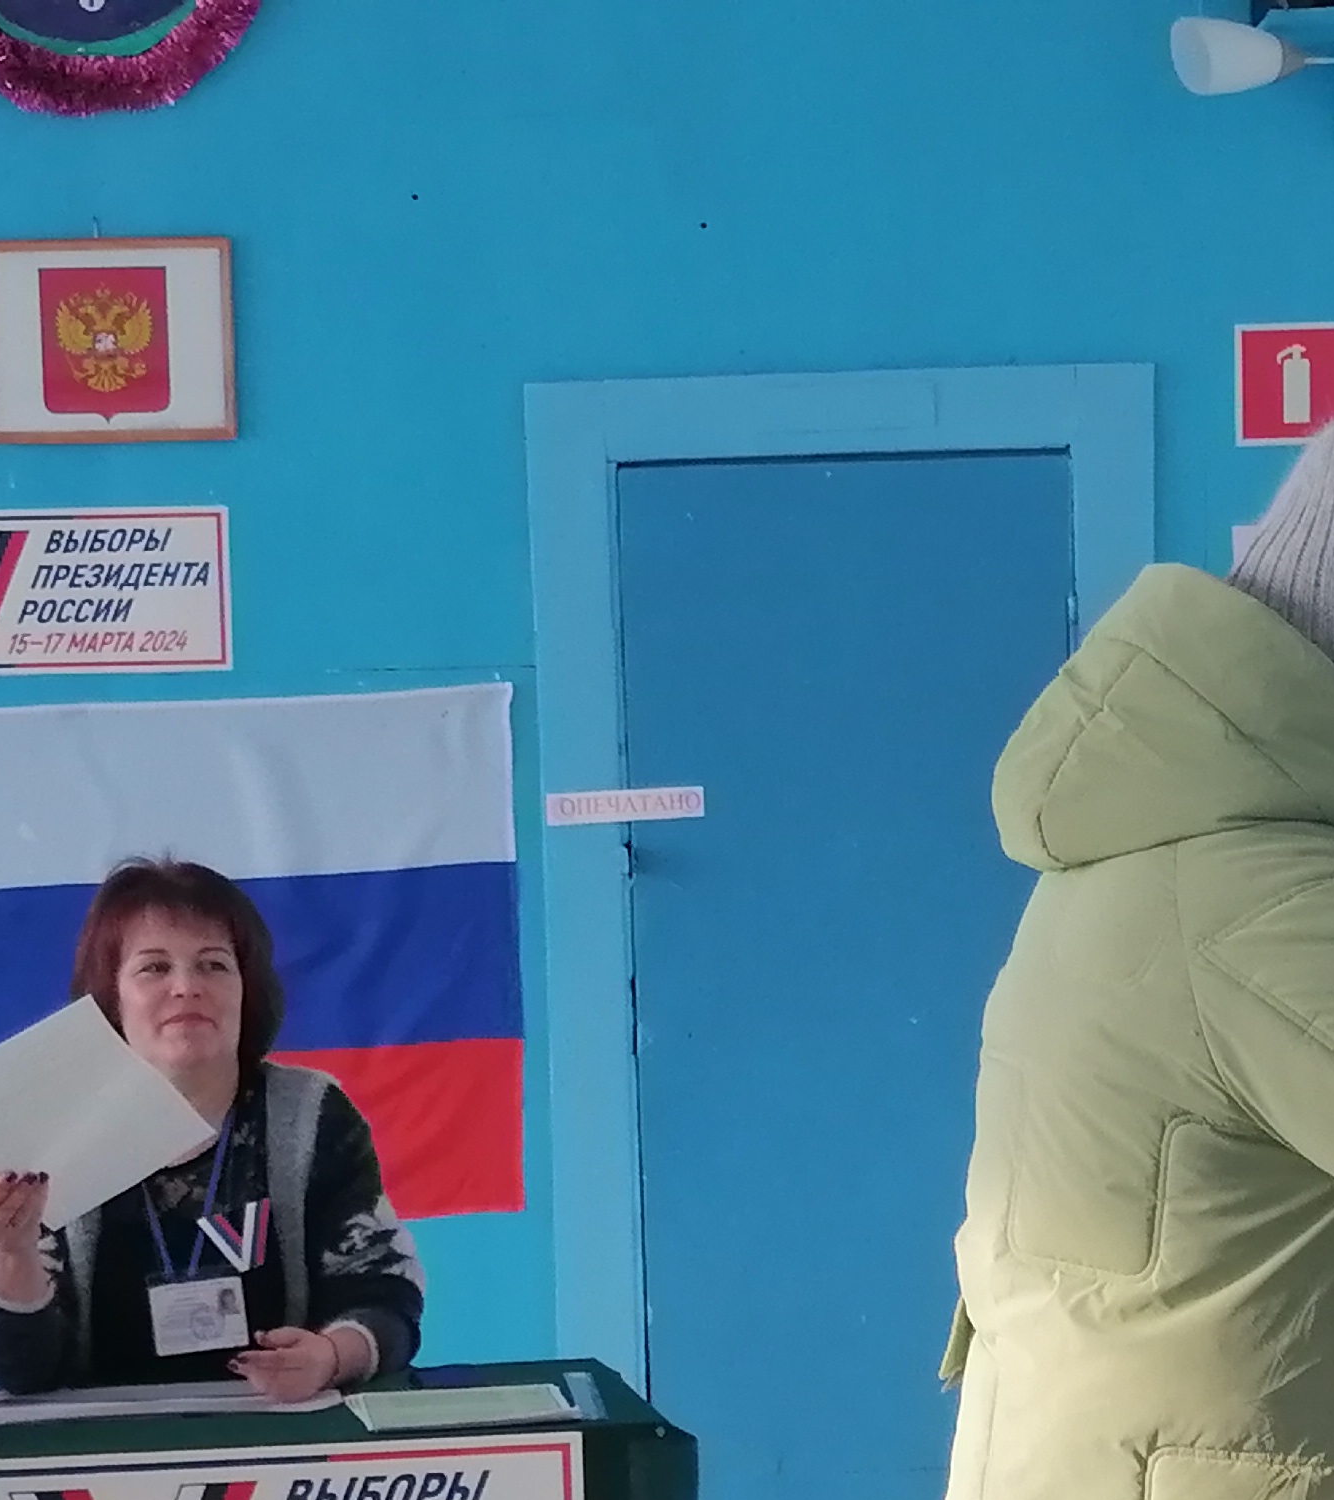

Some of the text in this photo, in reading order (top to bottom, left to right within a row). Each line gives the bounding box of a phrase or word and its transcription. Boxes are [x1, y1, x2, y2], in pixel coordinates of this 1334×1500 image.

[44, 528, 172, 554] ВЫБОРЫ
[30, 561, 211, 591] ПРЕЗИДЕНТА
[17, 598, 135, 625] РОССИИ
[66, 632, 134, 654] МАРТА
[138, 630, 189, 653] 2024
[559, 791, 702, 817] ОПЕЧАТАНО
